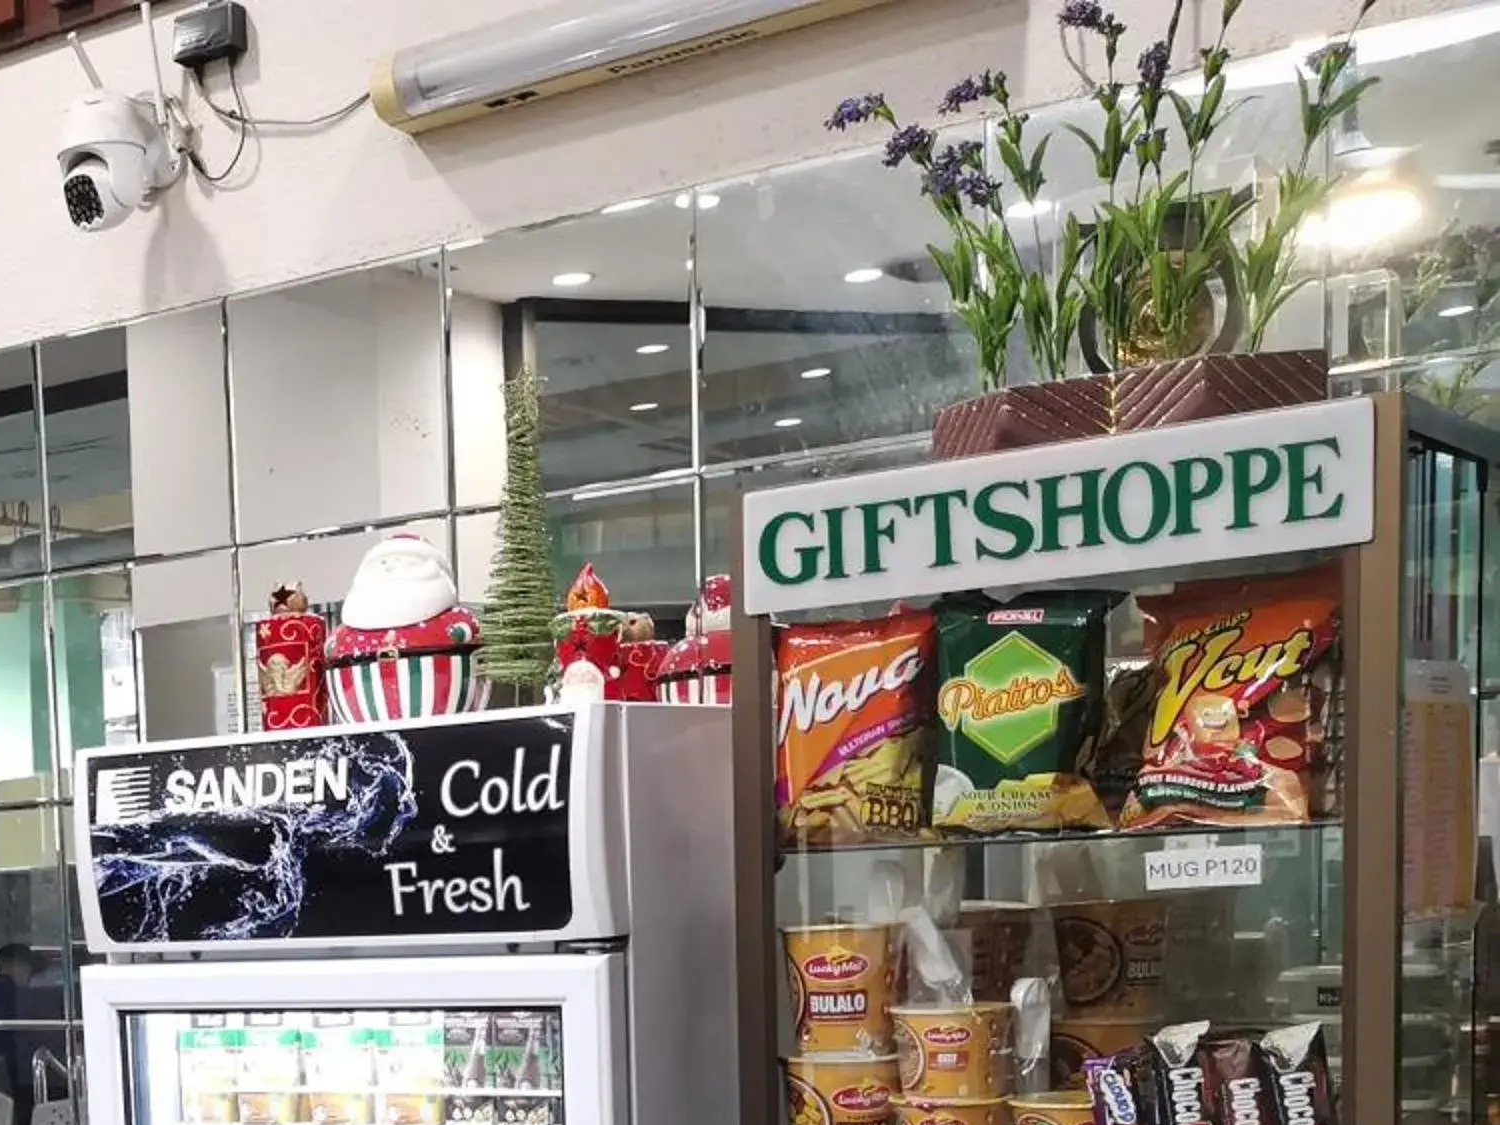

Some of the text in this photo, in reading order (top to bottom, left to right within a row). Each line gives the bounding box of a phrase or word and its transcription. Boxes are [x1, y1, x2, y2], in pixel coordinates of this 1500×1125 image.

[758, 437, 1345, 585] GIFTSHOPPE
[779, 646, 924, 745] Nova
[939, 664, 1087, 728] Piattos
[165, 758, 349, 813] SANDEN
[440, 744, 565, 817] Cold
[431, 824, 456, 854] &
[866, 797, 917, 830] BBQ
[384, 848, 530, 915] Fresh
[1149, 857, 1257, 880] MUG P120
[810, 993, 865, 1013] BULALO
